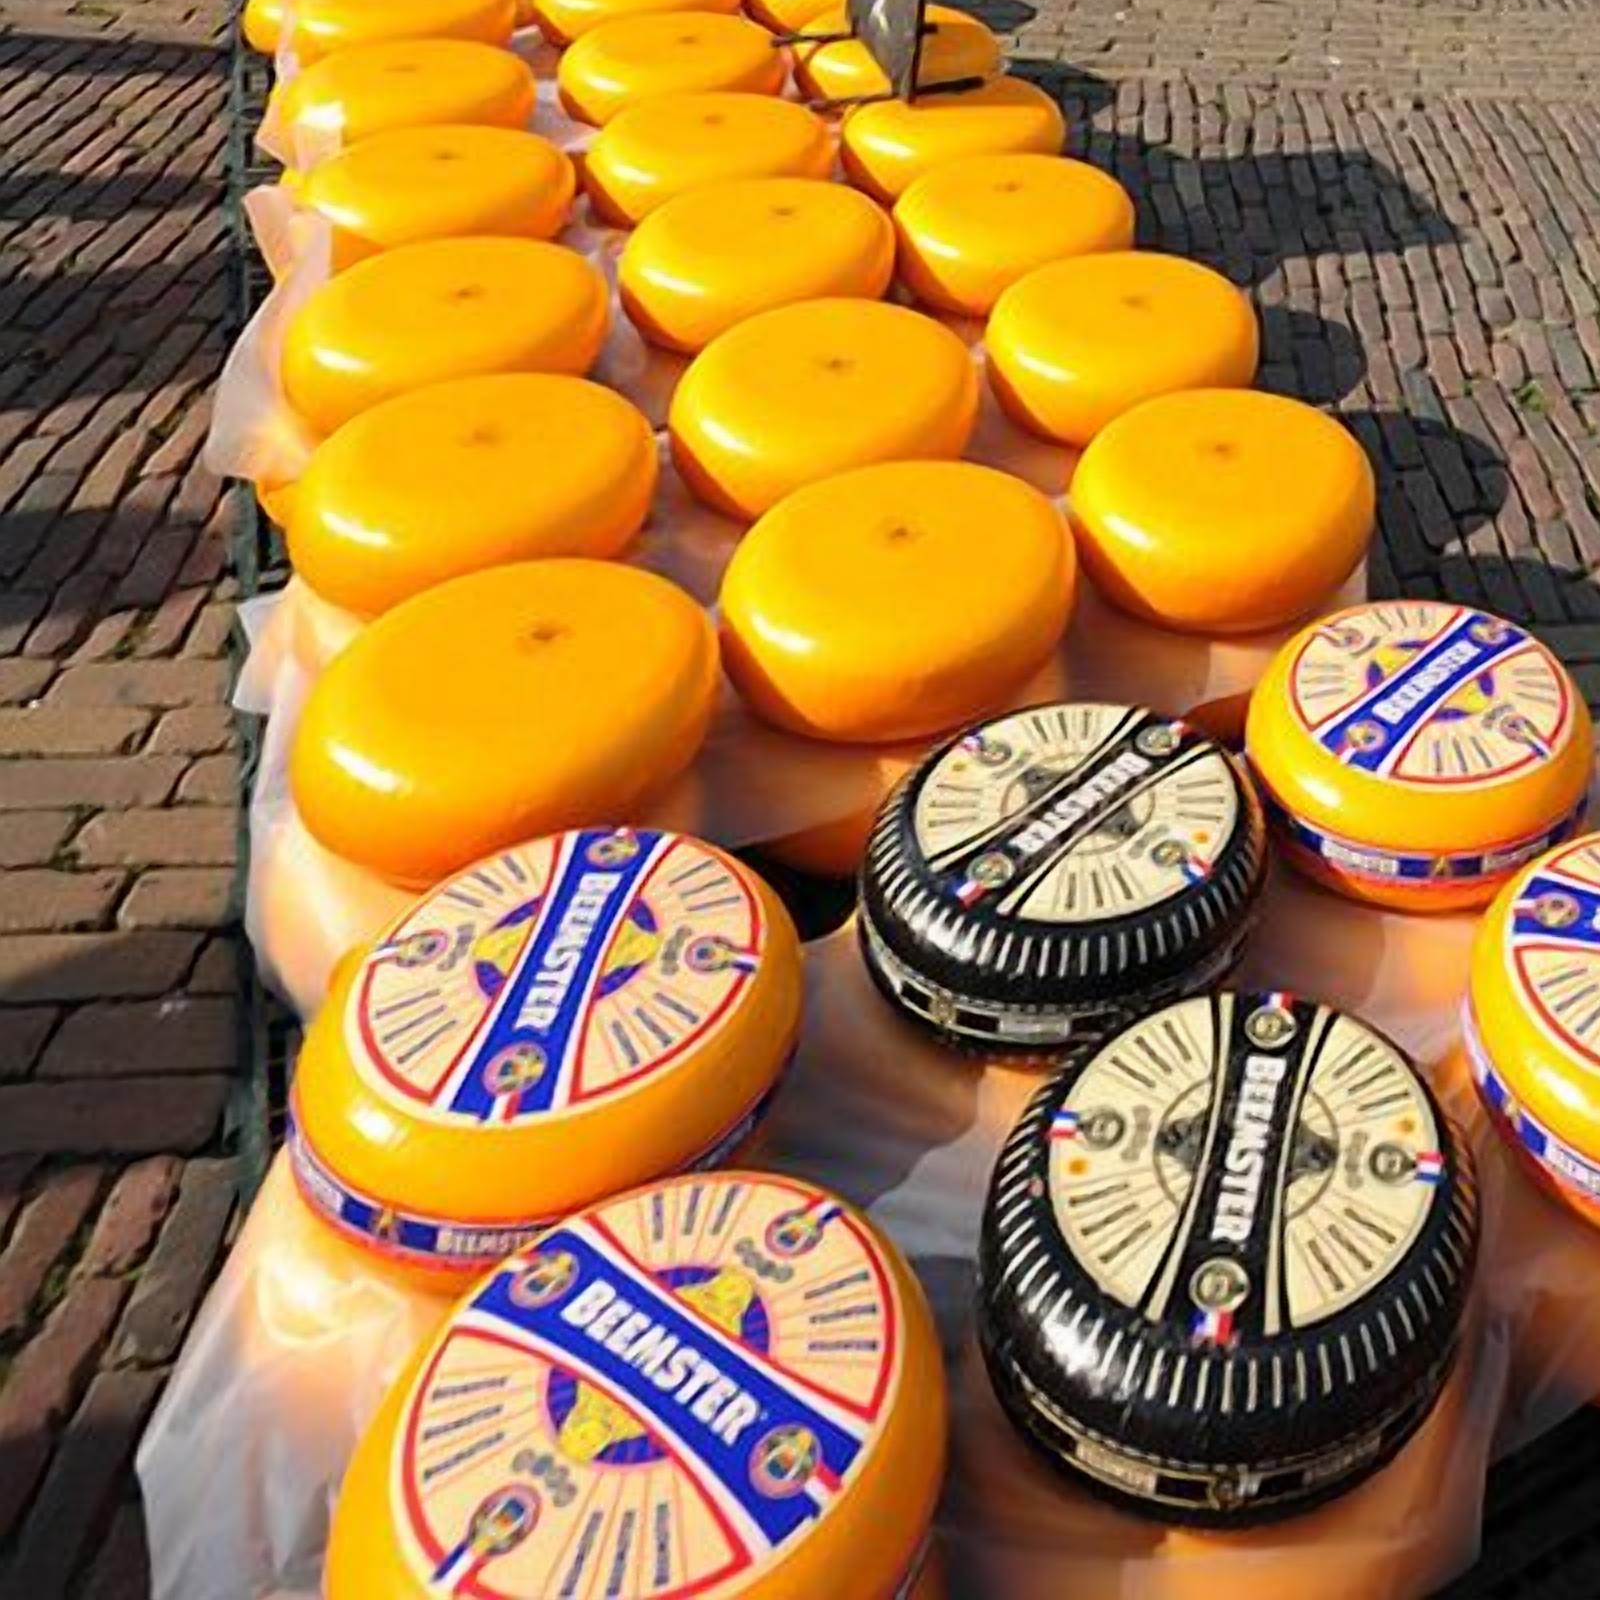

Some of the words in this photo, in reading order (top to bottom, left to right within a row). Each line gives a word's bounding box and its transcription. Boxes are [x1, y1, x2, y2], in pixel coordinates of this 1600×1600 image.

[514, 872, 623, 1033] BEEMSTER
[1210, 1056, 1286, 1241] BEEMSTER
[561, 1279, 757, 1445] BEEMSTER
